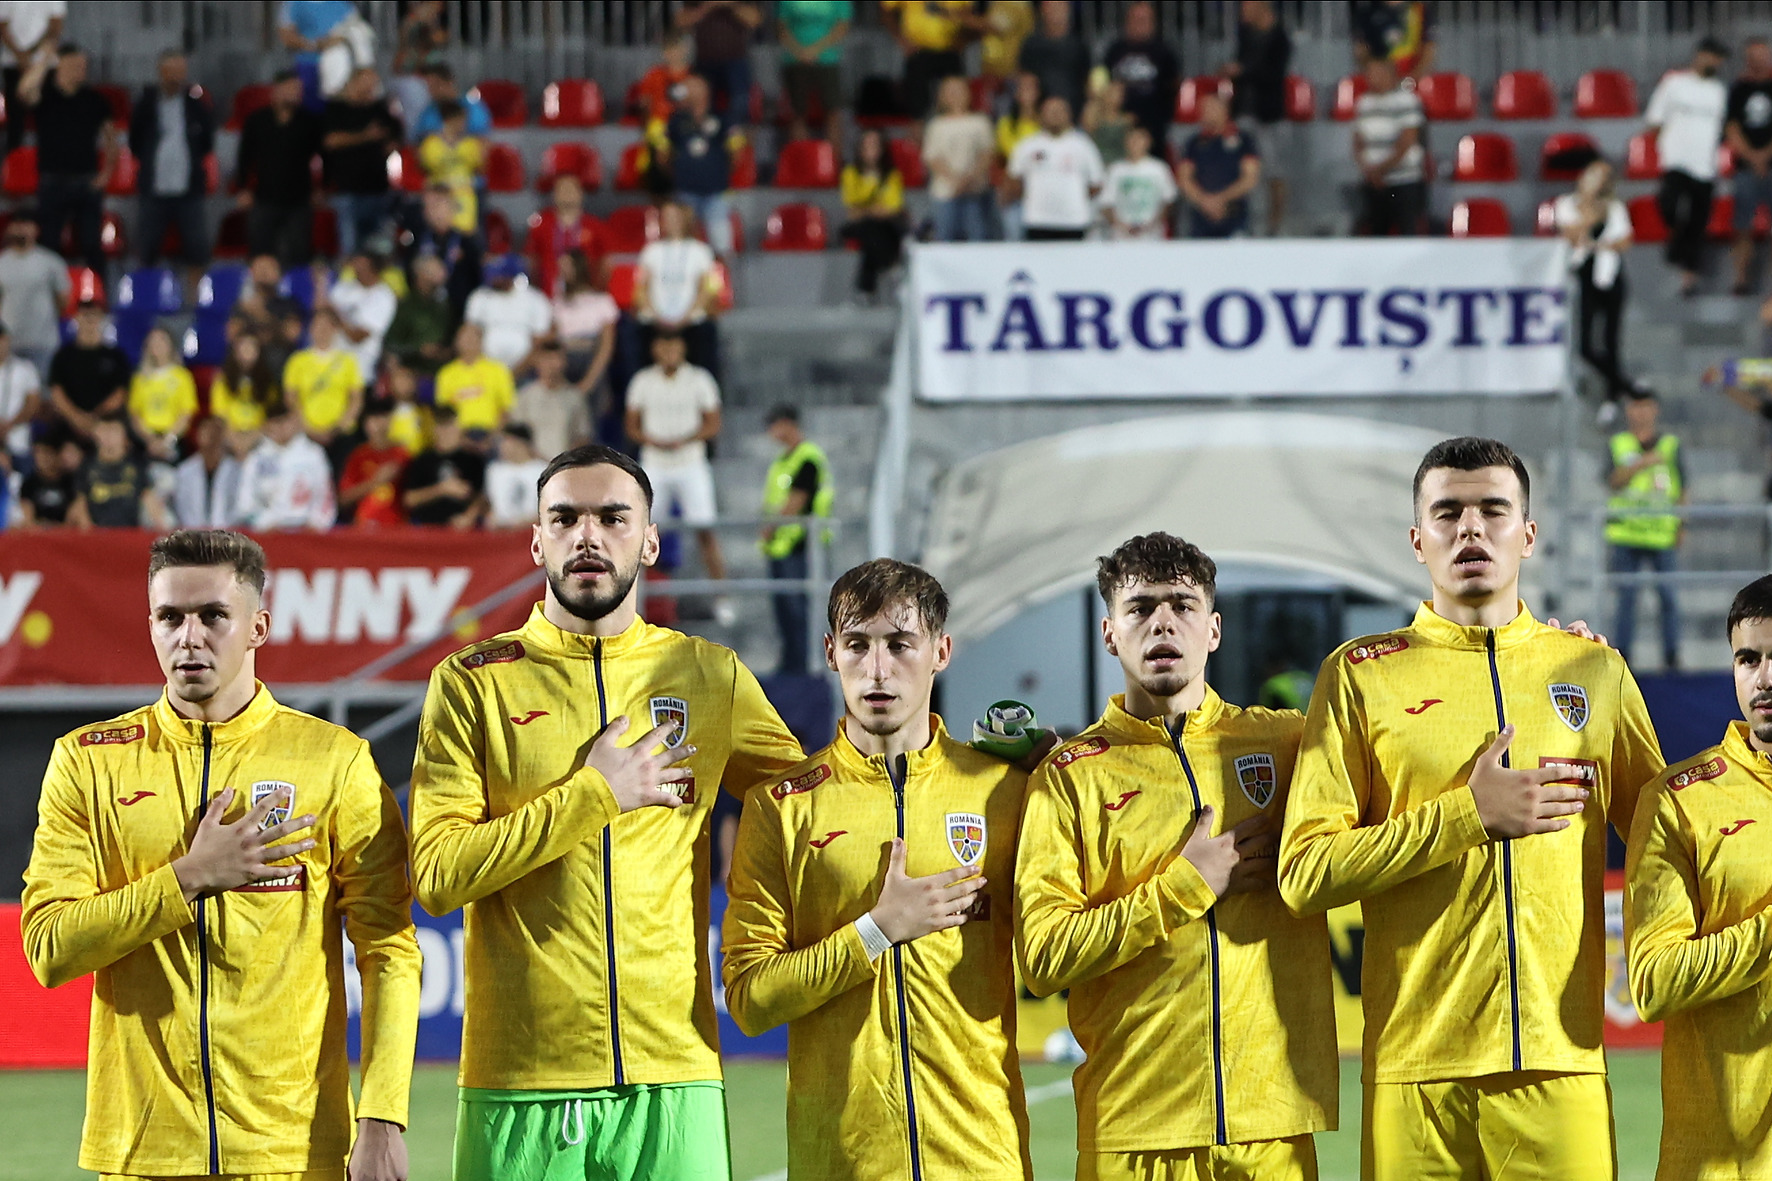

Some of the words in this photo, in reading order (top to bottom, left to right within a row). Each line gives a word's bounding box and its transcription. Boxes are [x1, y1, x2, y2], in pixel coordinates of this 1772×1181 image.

[1552, 684, 1583, 696] ROMÂNIA
[653, 698, 684, 710] ROMÂNIA
[103, 727, 138, 738] casa
[1238, 755, 1270, 768] ROMÂNIA
[1688, 761, 1719, 776] casa
[950, 815, 982, 826] ROMÂNIA
